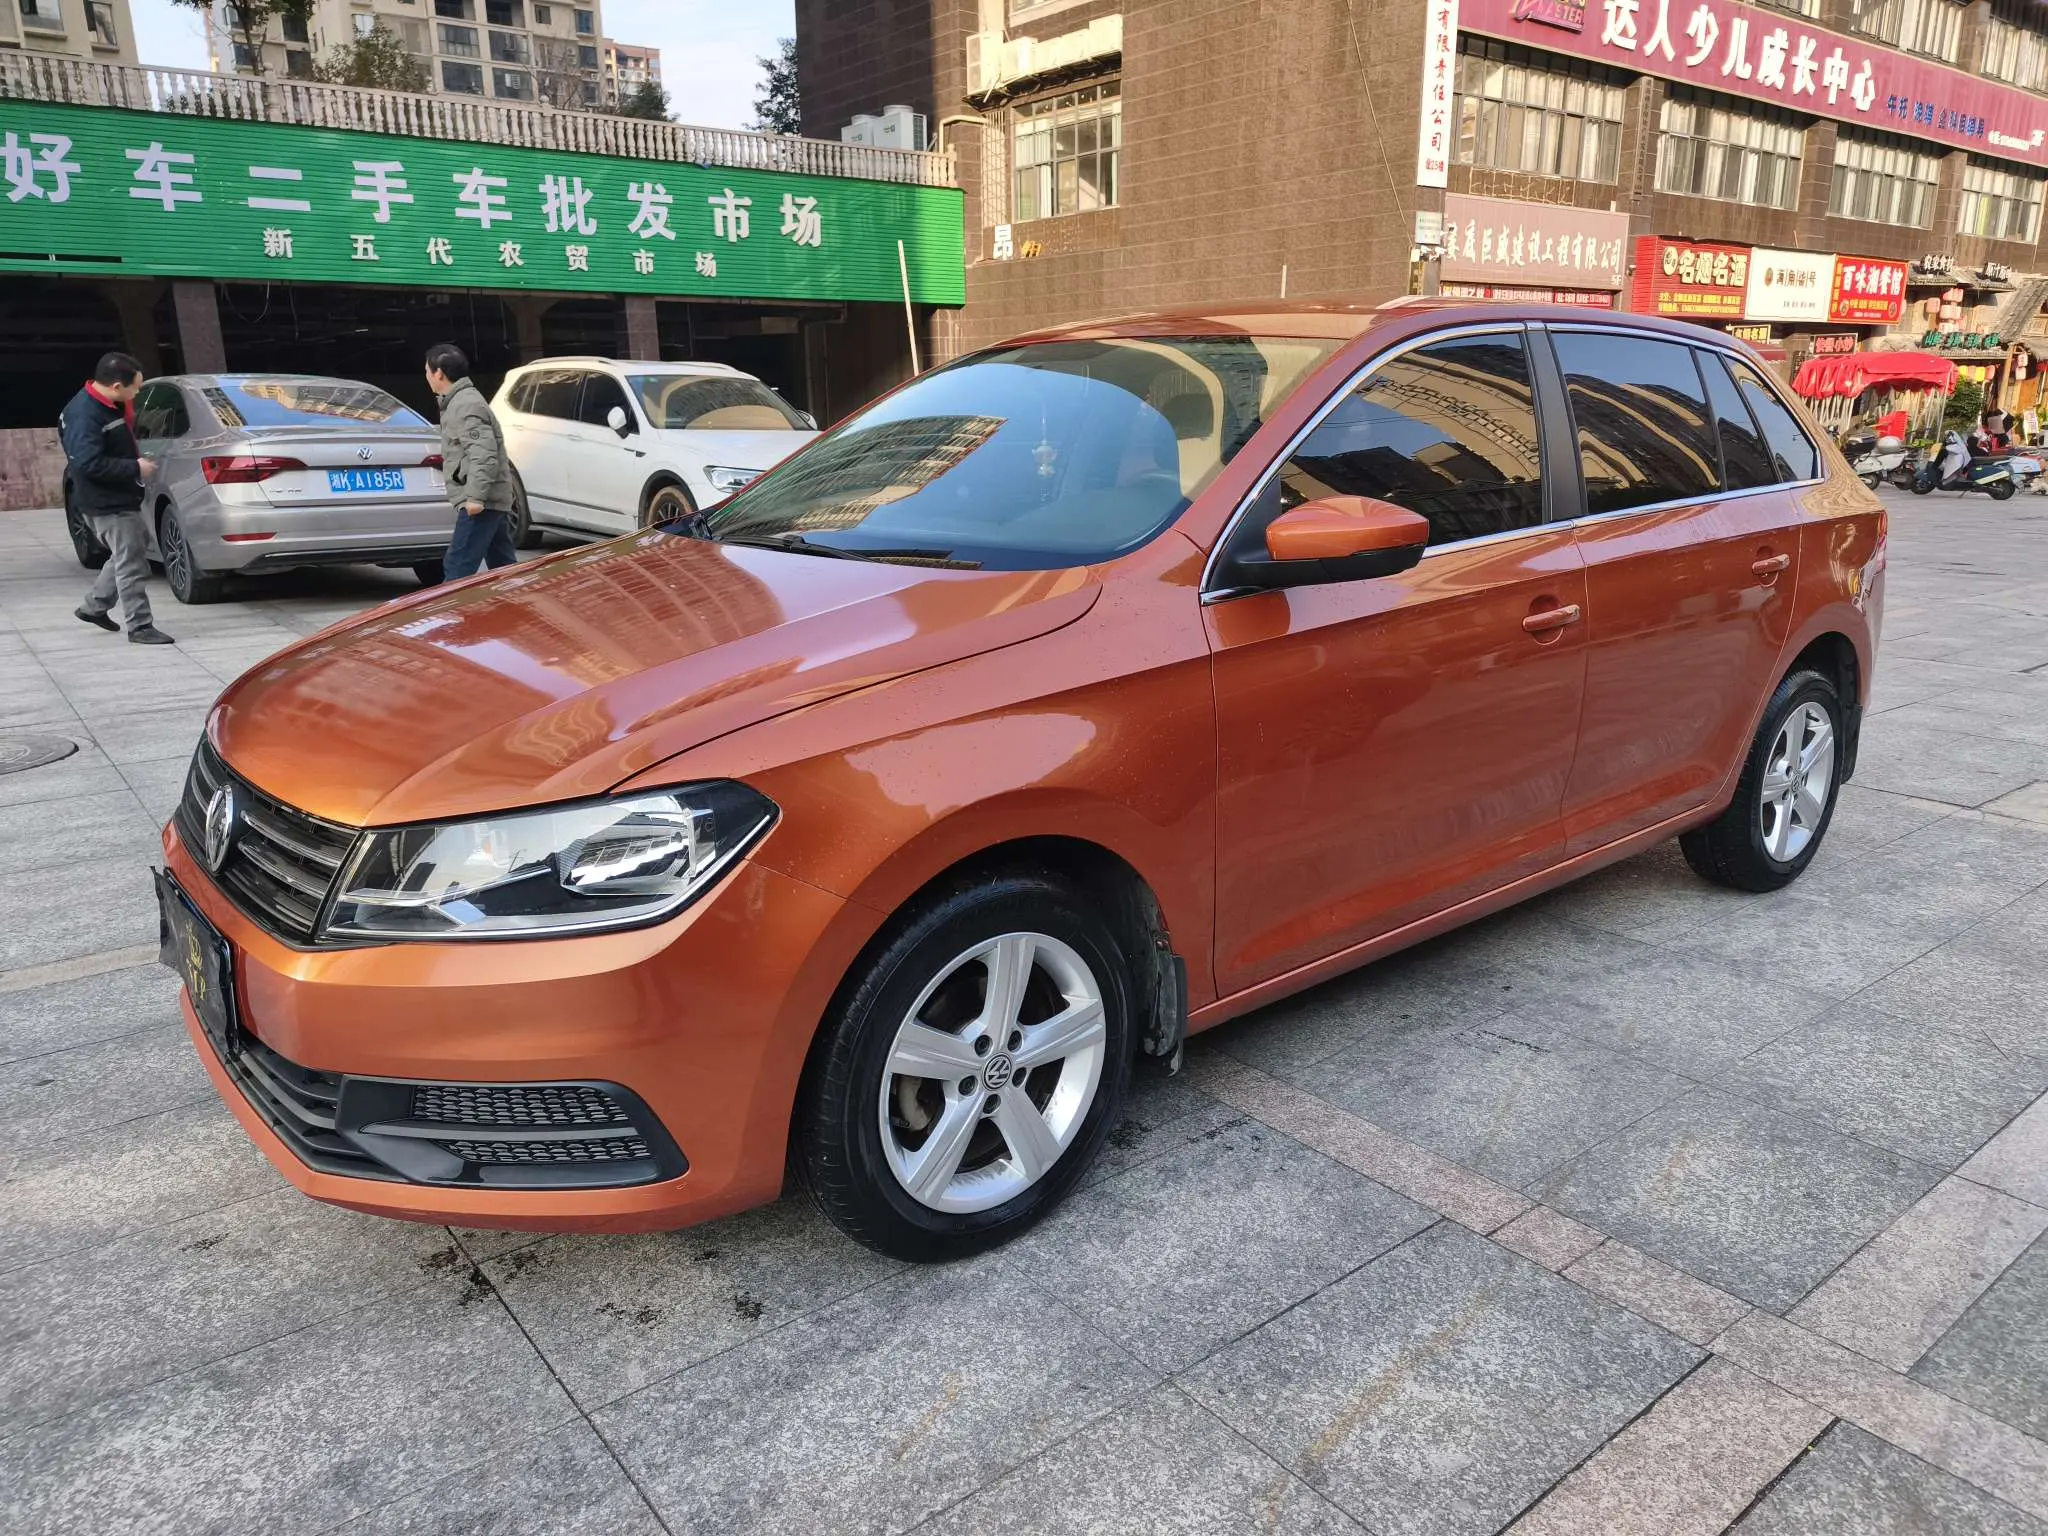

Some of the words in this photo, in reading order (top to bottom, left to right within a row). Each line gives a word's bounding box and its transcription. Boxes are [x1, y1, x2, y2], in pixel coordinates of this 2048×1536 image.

[1430, 0, 1451, 152] 有限责任公司
[1602, 0, 1876, 112] 达人少儿成长中心
[0, 131, 824, 248] 好车二手车批发市场
[263, 227, 717, 278] 新五代农贸市场
[1679, 249, 1748, 287] 名烟名酒
